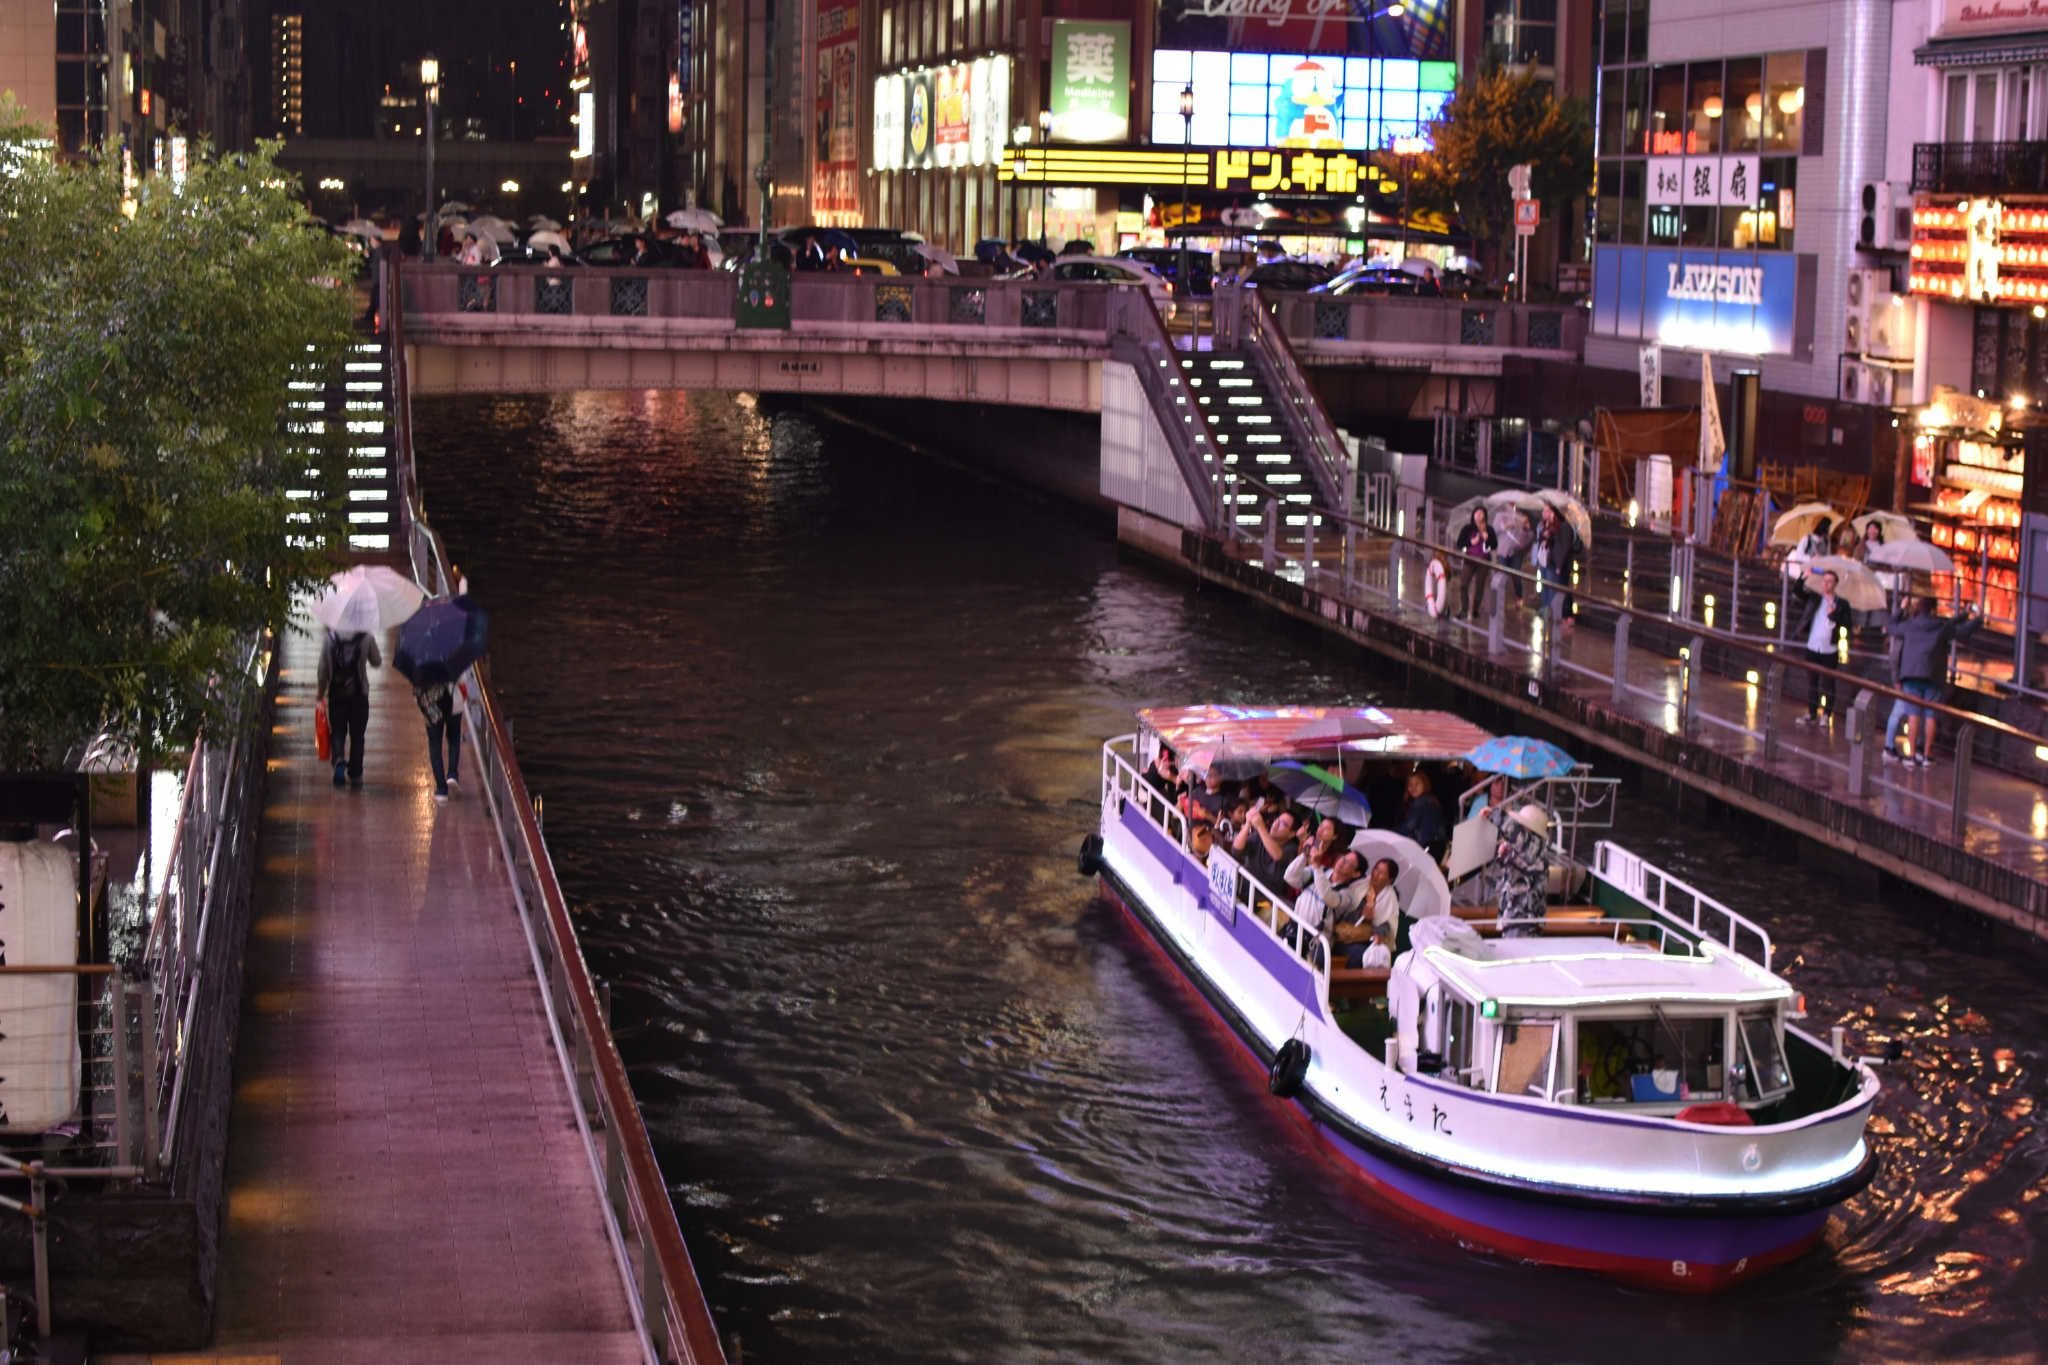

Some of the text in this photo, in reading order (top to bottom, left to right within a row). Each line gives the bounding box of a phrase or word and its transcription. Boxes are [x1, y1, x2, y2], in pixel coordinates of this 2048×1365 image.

[1066, 32, 1115, 84] 薬
[1064, 86, 1115, 98] Medicine
[1667, 263, 1762, 305] LAWSON
